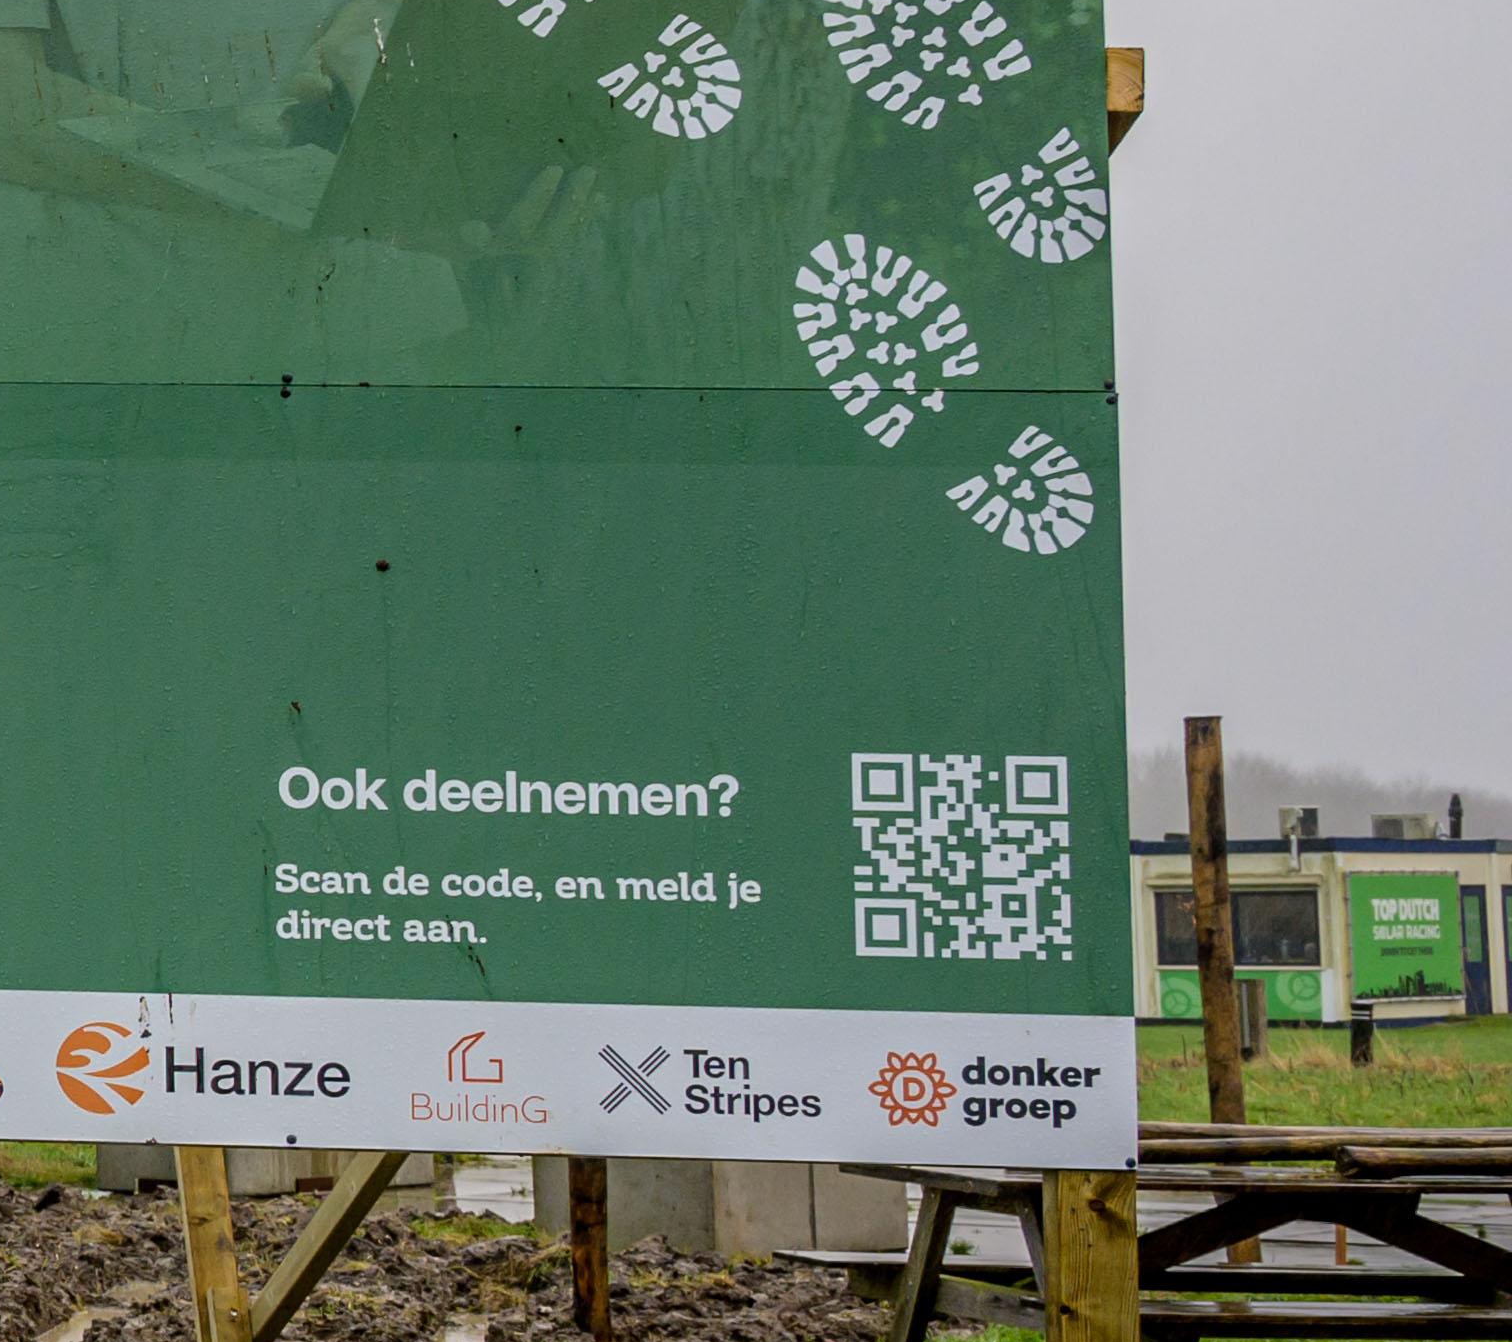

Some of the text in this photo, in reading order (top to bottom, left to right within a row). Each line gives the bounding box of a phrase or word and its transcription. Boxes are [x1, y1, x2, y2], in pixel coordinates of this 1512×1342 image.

[277, 765, 741, 819] Ook deelnemen?
[275, 862, 762, 911] Scan de code, en meld je
[1371, 898, 1397, 921] TOP
[275, 910, 488, 946] direct aan.
[164, 1045, 352, 1098] Hanze
[683, 1049, 750, 1080] Ten
[962, 1055, 1102, 1090] donker
[411, 1092, 548, 1124] BuildinG
[683, 1084, 822, 1120] Stripes
[961, 1093, 1078, 1129] groep
